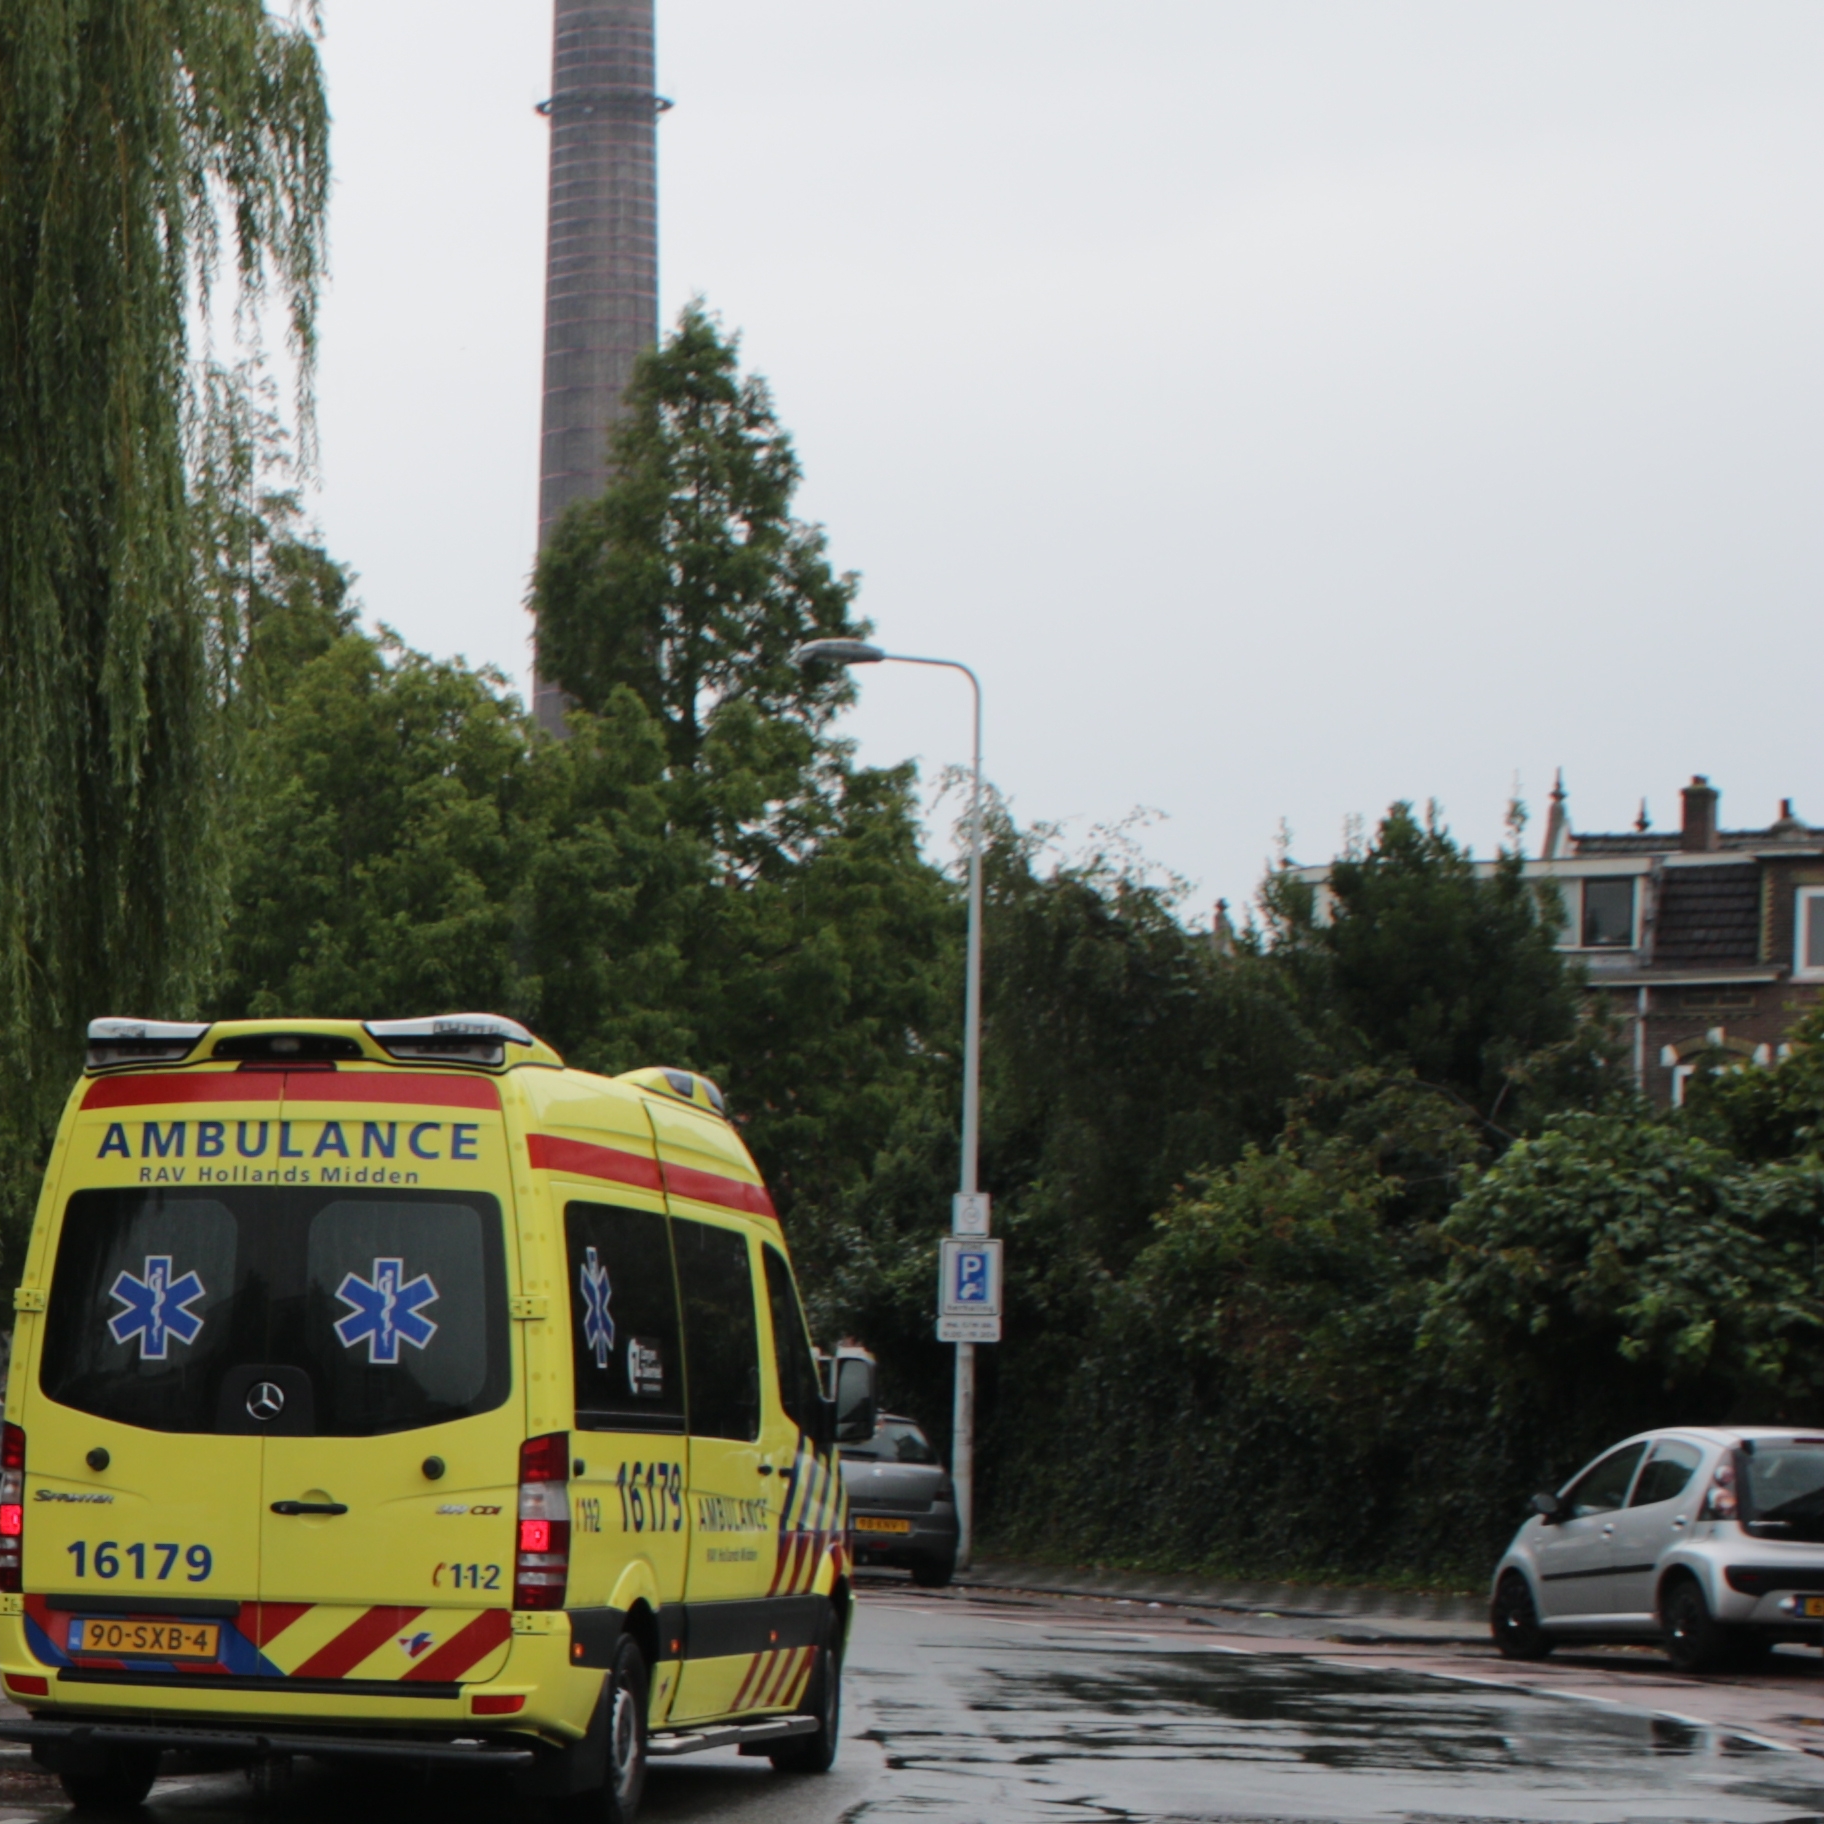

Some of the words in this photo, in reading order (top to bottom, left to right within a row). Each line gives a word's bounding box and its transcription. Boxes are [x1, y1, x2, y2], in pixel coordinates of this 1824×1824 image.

[95, 1120, 480, 1161] AMBULANCE
[138, 1166, 186, 1183] RAV
[198, 1165, 311, 1184] Hollands
[320, 1166, 421, 1185] Midden
[470, 1505, 504, 1516] CDI
[616, 1461, 682, 1532] 16179
[698, 1497, 768, 1532] AMBULANCE
[66, 1540, 213, 1582] 16179
[450, 1563, 501, 1590] 1-1-2
[90, 1624, 209, 1653] 90-SXB-4
